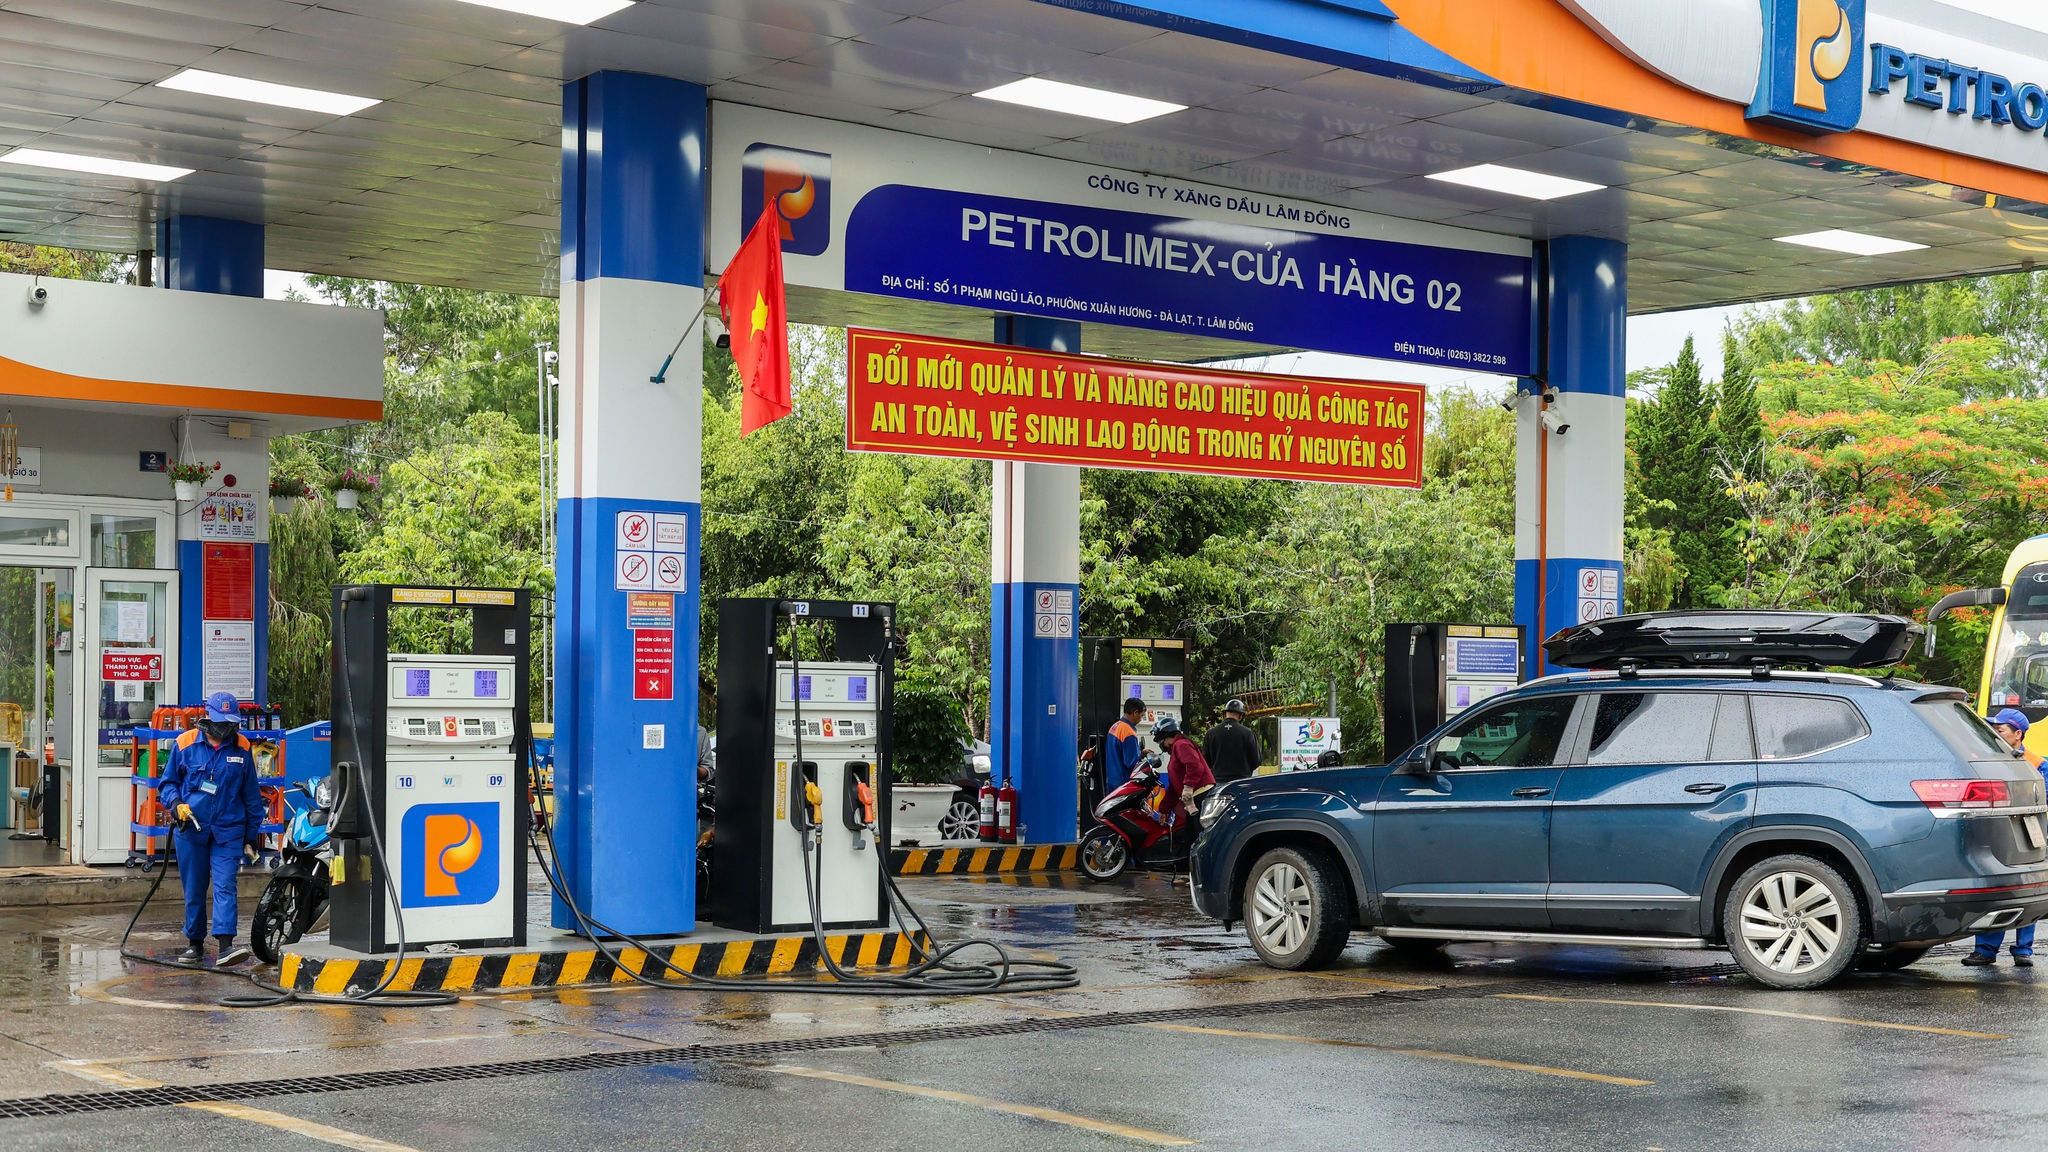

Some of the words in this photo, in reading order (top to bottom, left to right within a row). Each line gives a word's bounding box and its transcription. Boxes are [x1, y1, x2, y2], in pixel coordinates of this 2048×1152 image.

[1869, 42, 2048, 137] PETRO
[1088, 175, 1139, 194] CÔNG
[1146, 184, 1167, 199] TY
[1174, 188, 1221, 208] XĂNG
[1227, 196, 1261, 215] DẦU
[1266, 204, 1300, 221] LÂM
[1304, 209, 1350, 229] ĐỒNG
[882, 275, 902, 289] ĐỊA
[933, 278, 950, 294] SỐ
[952, 285, 957, 295] 1
[961, 285, 992, 301] PHẠM
[995, 289, 1018, 302] NGŨ
[1020, 291, 1045, 307] LÃO,
[1047, 296, 1087, 311] PHƯỜNG
[1090, 302, 1116, 315] XUÂN
[1119, 306, 1152, 319] HƯƠNG
[1160, 310, 1173, 322] ĐÀ
[1208, 316, 1226, 329] LÂM
[1318, 258, 1415, 304] HÀNG
[1426, 280, 1462, 312] 02
[1394, 341, 1415, 356] ĐIỆN
[1418, 345, 1446, 359] THOẠI:
[1447, 348, 1471, 363] (0263)
[1473, 352, 1490, 363] 3822
[1493, 355, 1506, 365] 598
[866, 343, 909, 386] ĐỔI
[916, 354, 963, 391] MỚI
[970, 356, 1034, 397] QUẢN
[1041, 365, 1067, 400] LÝ
[1073, 368, 1101, 403] VÀ
[1108, 372, 1168, 409] NÂNG
[1174, 382, 1215, 413] CAO
[1221, 384, 1267, 422] HIỆU
[1272, 385, 1312, 422] QUẢ
[1317, 392, 1370, 426] CÔNG
[1374, 397, 1409, 430] TÁC
[871, 401, 906, 434] AN
[913, 401, 983, 443] TOÀN,
[990, 406, 1018, 448] VỆ
[1025, 414, 1080, 448] SINH
[1086, 418, 1126, 451] LAO
[1132, 418, 1190, 458] ĐỘNG
[1196, 427, 1263, 460] TRONG
[1268, 426, 1294, 462] KỶ
[1299, 435, 1376, 468] NGUYÊN
[1381, 434, 1407, 470] SỐ
[150, 454, 156, 464] 2
[796, 604, 806, 613] 12
[856, 606, 866, 615] 11
[400, 777, 412, 787] 10
[490, 776, 502, 785] 09
